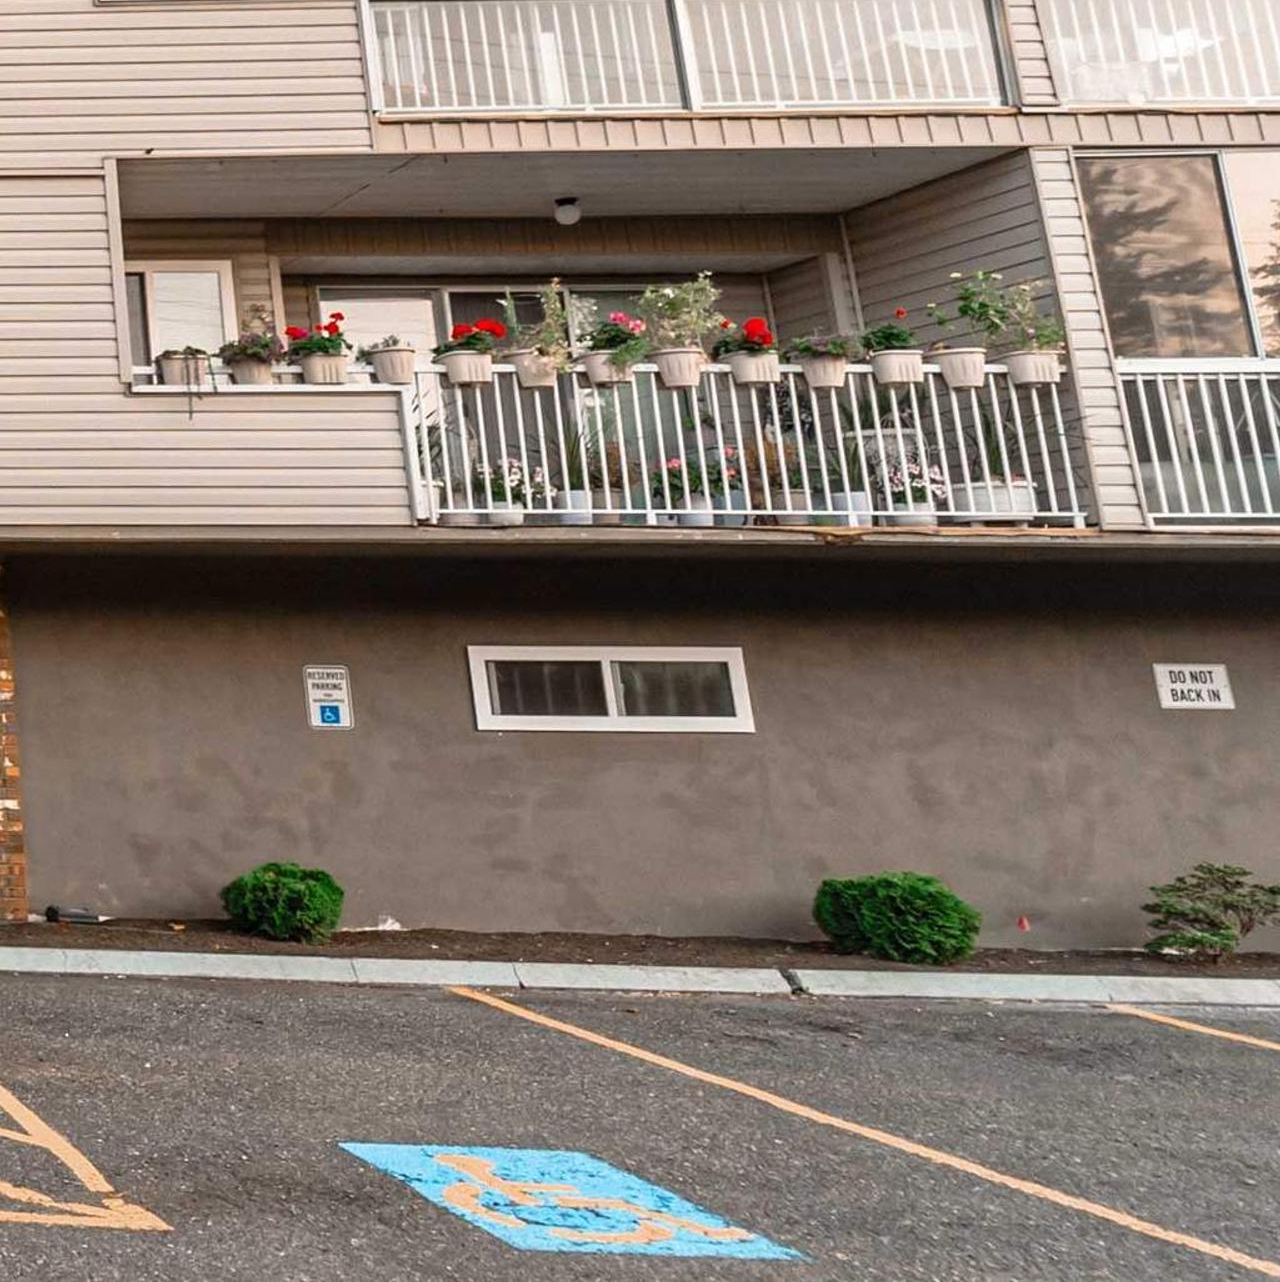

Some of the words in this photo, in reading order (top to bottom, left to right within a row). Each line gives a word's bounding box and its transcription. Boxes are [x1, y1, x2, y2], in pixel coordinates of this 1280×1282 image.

[307, 671, 344, 681] RESERVED
[1168, 670, 1186, 684] DO
[1189, 670, 1214, 684] NOT
[311, 682, 343, 691] PARKING
[1170, 688, 1205, 702] BACK
[1207, 689, 1222, 702] IN
